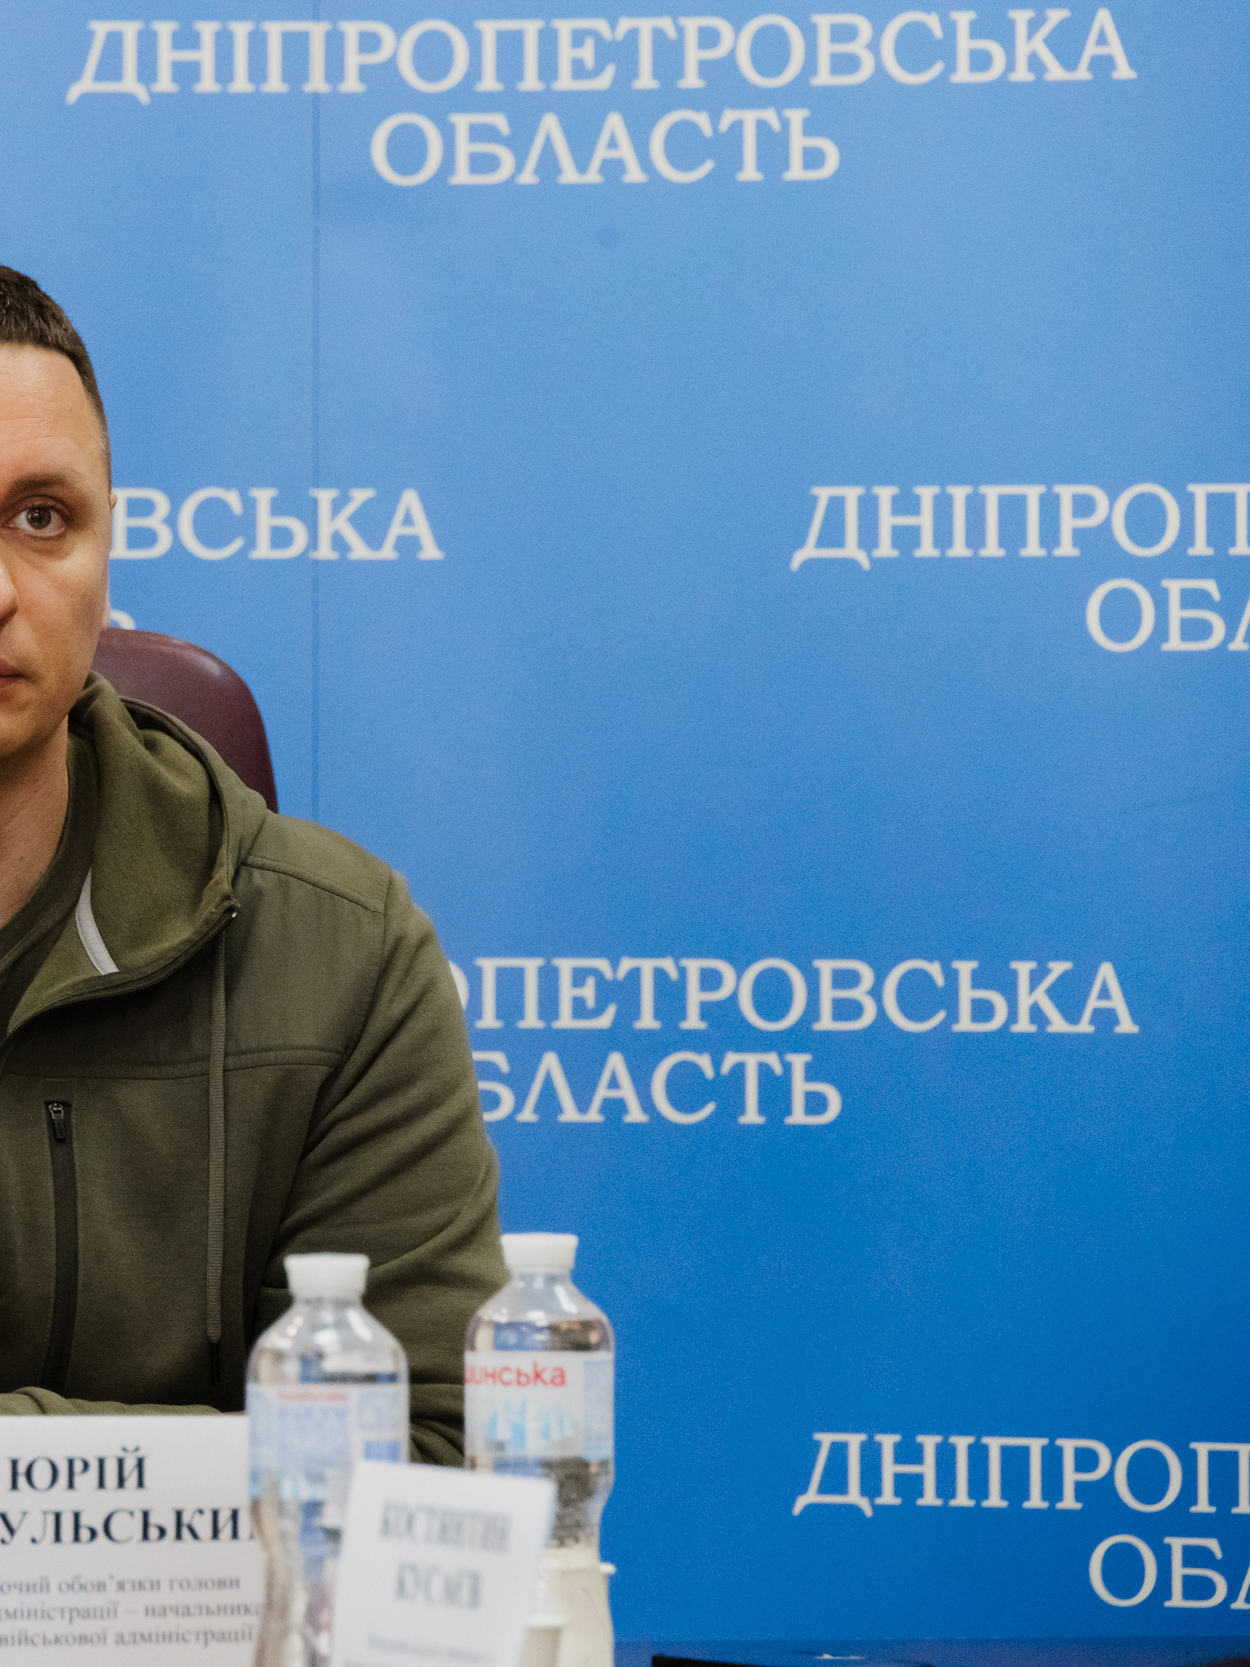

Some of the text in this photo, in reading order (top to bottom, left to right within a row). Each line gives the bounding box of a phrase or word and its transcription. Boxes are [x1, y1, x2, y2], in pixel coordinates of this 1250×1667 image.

[65, 7, 1138, 105] ДНІПРОПЕТРОВСЬКА
[368, 108, 842, 187] ОБЛАСТЬ
[789, 482, 1250, 572] ДНІПРОП
[9, 1446, 148, 1492] ЮРІЙ
[791, 1432, 1250, 1518] ДНІПРОП
[169, 1574, 241, 1595] голови
